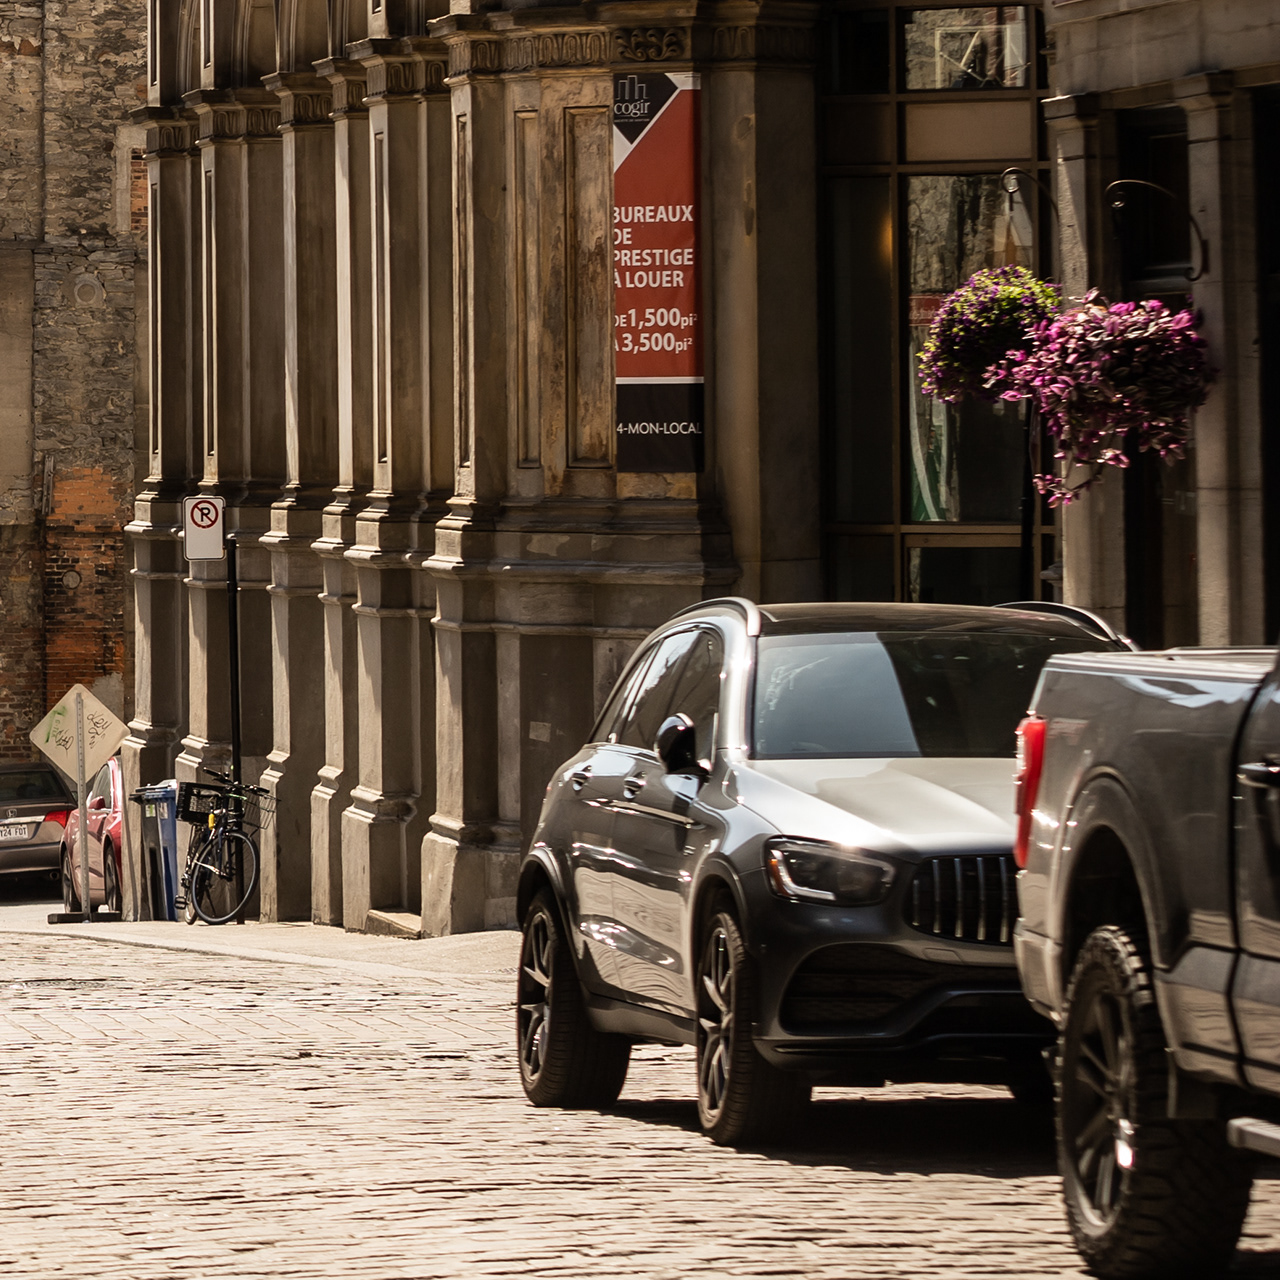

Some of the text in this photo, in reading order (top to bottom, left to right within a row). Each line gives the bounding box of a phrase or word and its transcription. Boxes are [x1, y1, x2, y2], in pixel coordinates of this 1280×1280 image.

[614, 100, 650, 117] cogir
[614, 205, 694, 223] BUREAUX
[614, 249, 694, 266] PRESTIGE
[625, 271, 684, 288] LOUER
